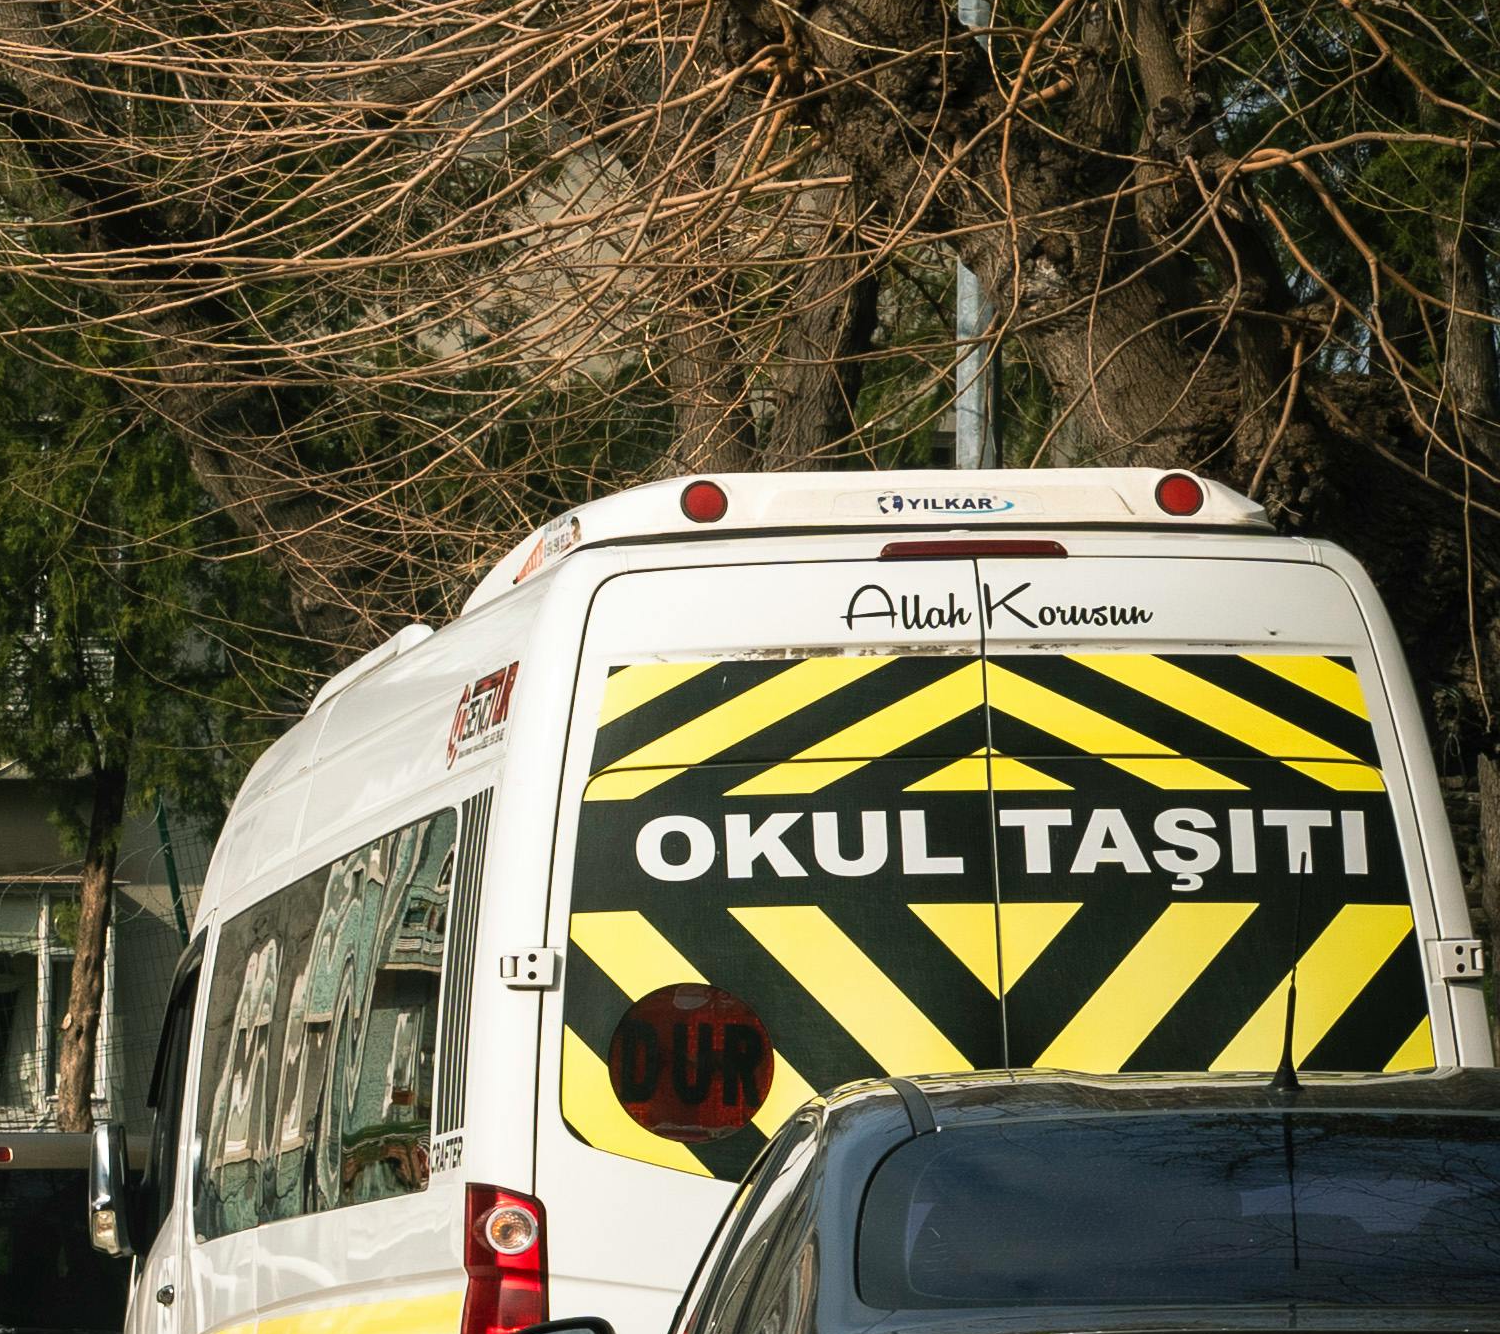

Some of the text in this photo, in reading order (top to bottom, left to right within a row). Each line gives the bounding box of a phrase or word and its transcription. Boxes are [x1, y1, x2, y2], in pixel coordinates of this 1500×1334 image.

[907, 498, 995, 510] YILKAR
[840, 582, 1153, 629] Allah Korusun
[636, 808, 1368, 892] OKUL TAŞITI
[621, 1019, 764, 1108] DUR
[431, 1136, 463, 1174] CRAFTER
